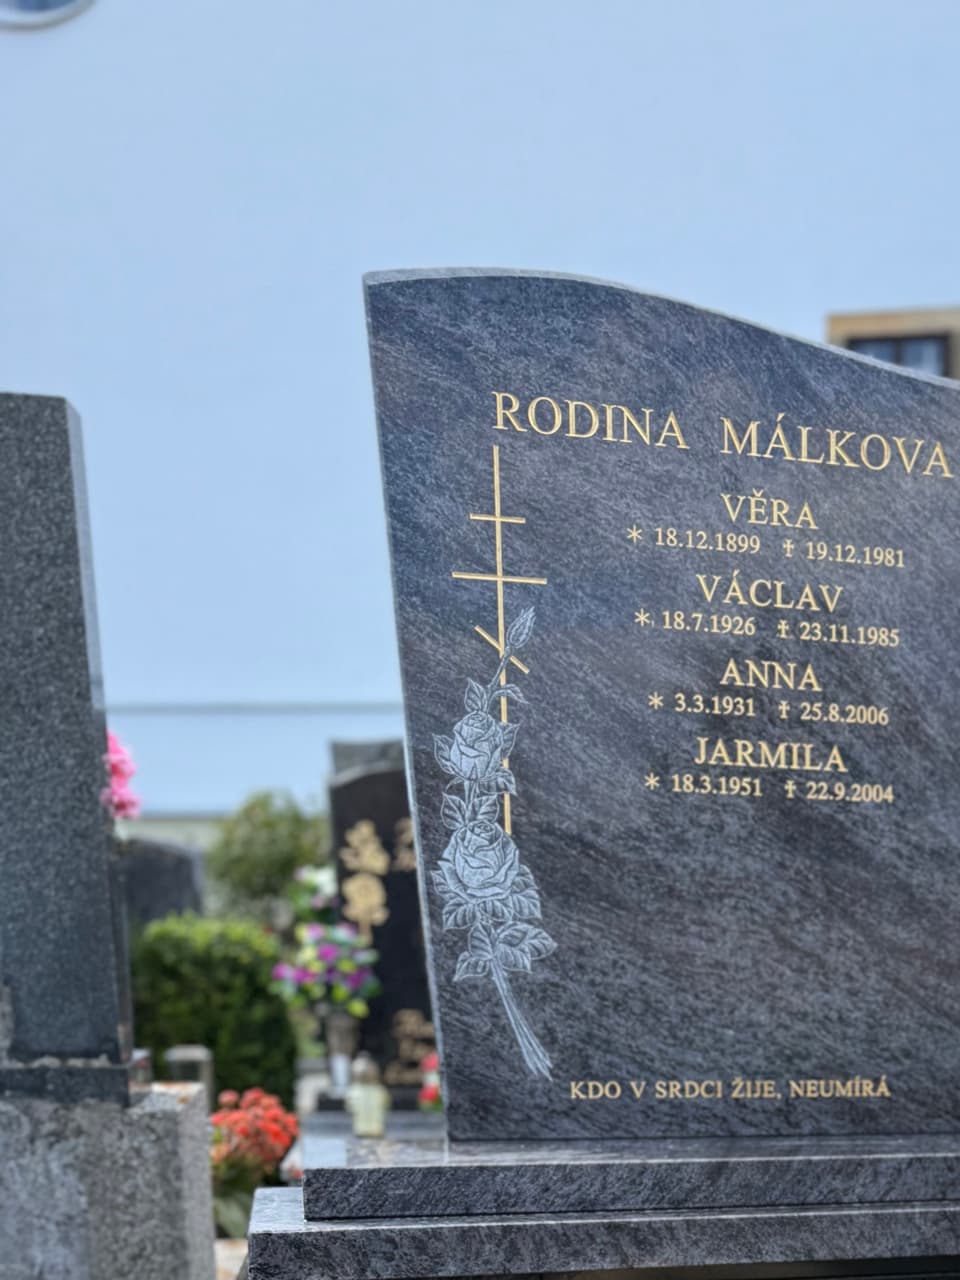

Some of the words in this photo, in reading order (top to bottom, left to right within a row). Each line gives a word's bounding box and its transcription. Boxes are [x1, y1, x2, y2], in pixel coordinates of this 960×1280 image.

[492, 391, 690, 451] RODINA
[719, 412, 955, 479] MÁLKOVA
[721, 489, 819, 531] VĚRA
[654, 527, 762, 555] 18.12.1899
[805, 541, 906, 569] 19.12.1981
[695, 570, 844, 613] VÁCLAV
[661, 609, 757, 637] 18.7.1926
[798, 620, 901, 648] 23.11.1985
[719, 658, 823, 692] ANNA
[673, 692, 757, 718] 3.3.1931
[799, 703, 890, 727] 25.8.2006
[694, 736, 850, 773] JARMILA
[671, 773, 763, 798] 18.3.1951
[805, 780, 896, 803] 22.9.2004
[569, 1080, 623, 1100] KDO
[630, 1081, 647, 1100] V
[655, 1080, 723, 1100] SRDCI
[731, 1076, 782, 1101] ŽIJE,
[789, 1074, 892, 1100] NEUMÍRA
